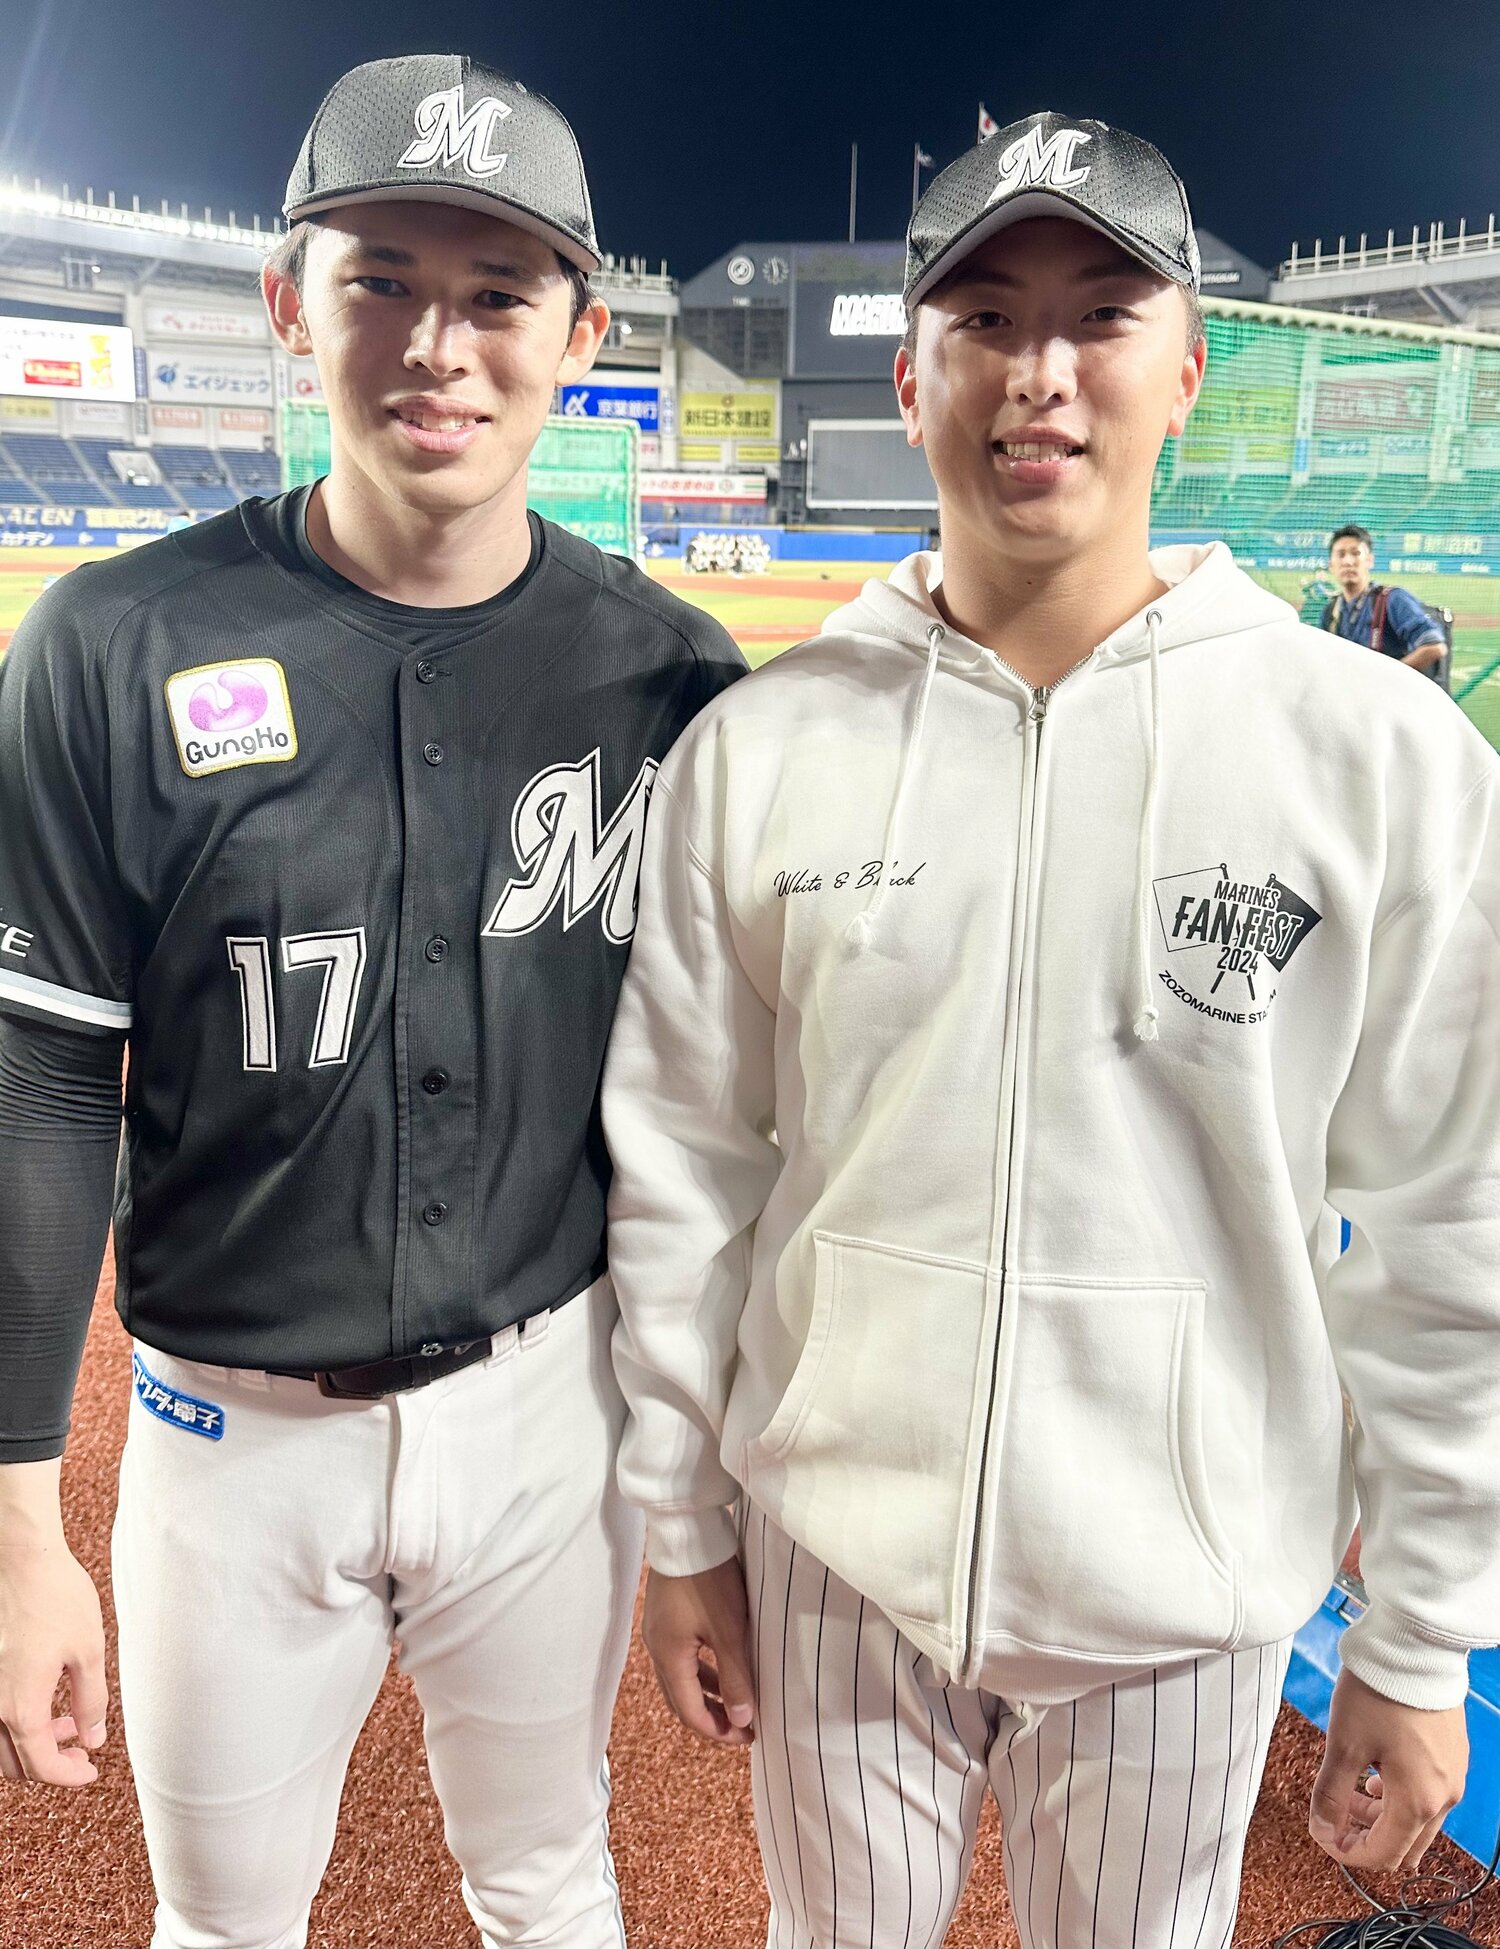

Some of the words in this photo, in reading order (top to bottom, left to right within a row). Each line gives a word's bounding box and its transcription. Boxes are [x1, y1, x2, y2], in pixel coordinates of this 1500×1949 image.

[397, 84, 512, 178] M
[985, 123, 1092, 208] M
[184, 375, 271, 394] エイジェック
[685, 408, 771, 428] 新日本建設
[186, 727, 290, 765] GungHo
[480, 746, 660, 945] M
[773, 868, 822, 898] White
[833, 871, 850, 889] &
[1213, 879, 1279, 911] MARINES
[1172, 896, 1240, 946] FAN
[1239, 906, 1305, 960] FEST
[1217, 946, 1258, 975] 2024
[226, 926, 367, 1073] 17
[1158, 970, 1246, 1024] ZOZOMARINE
